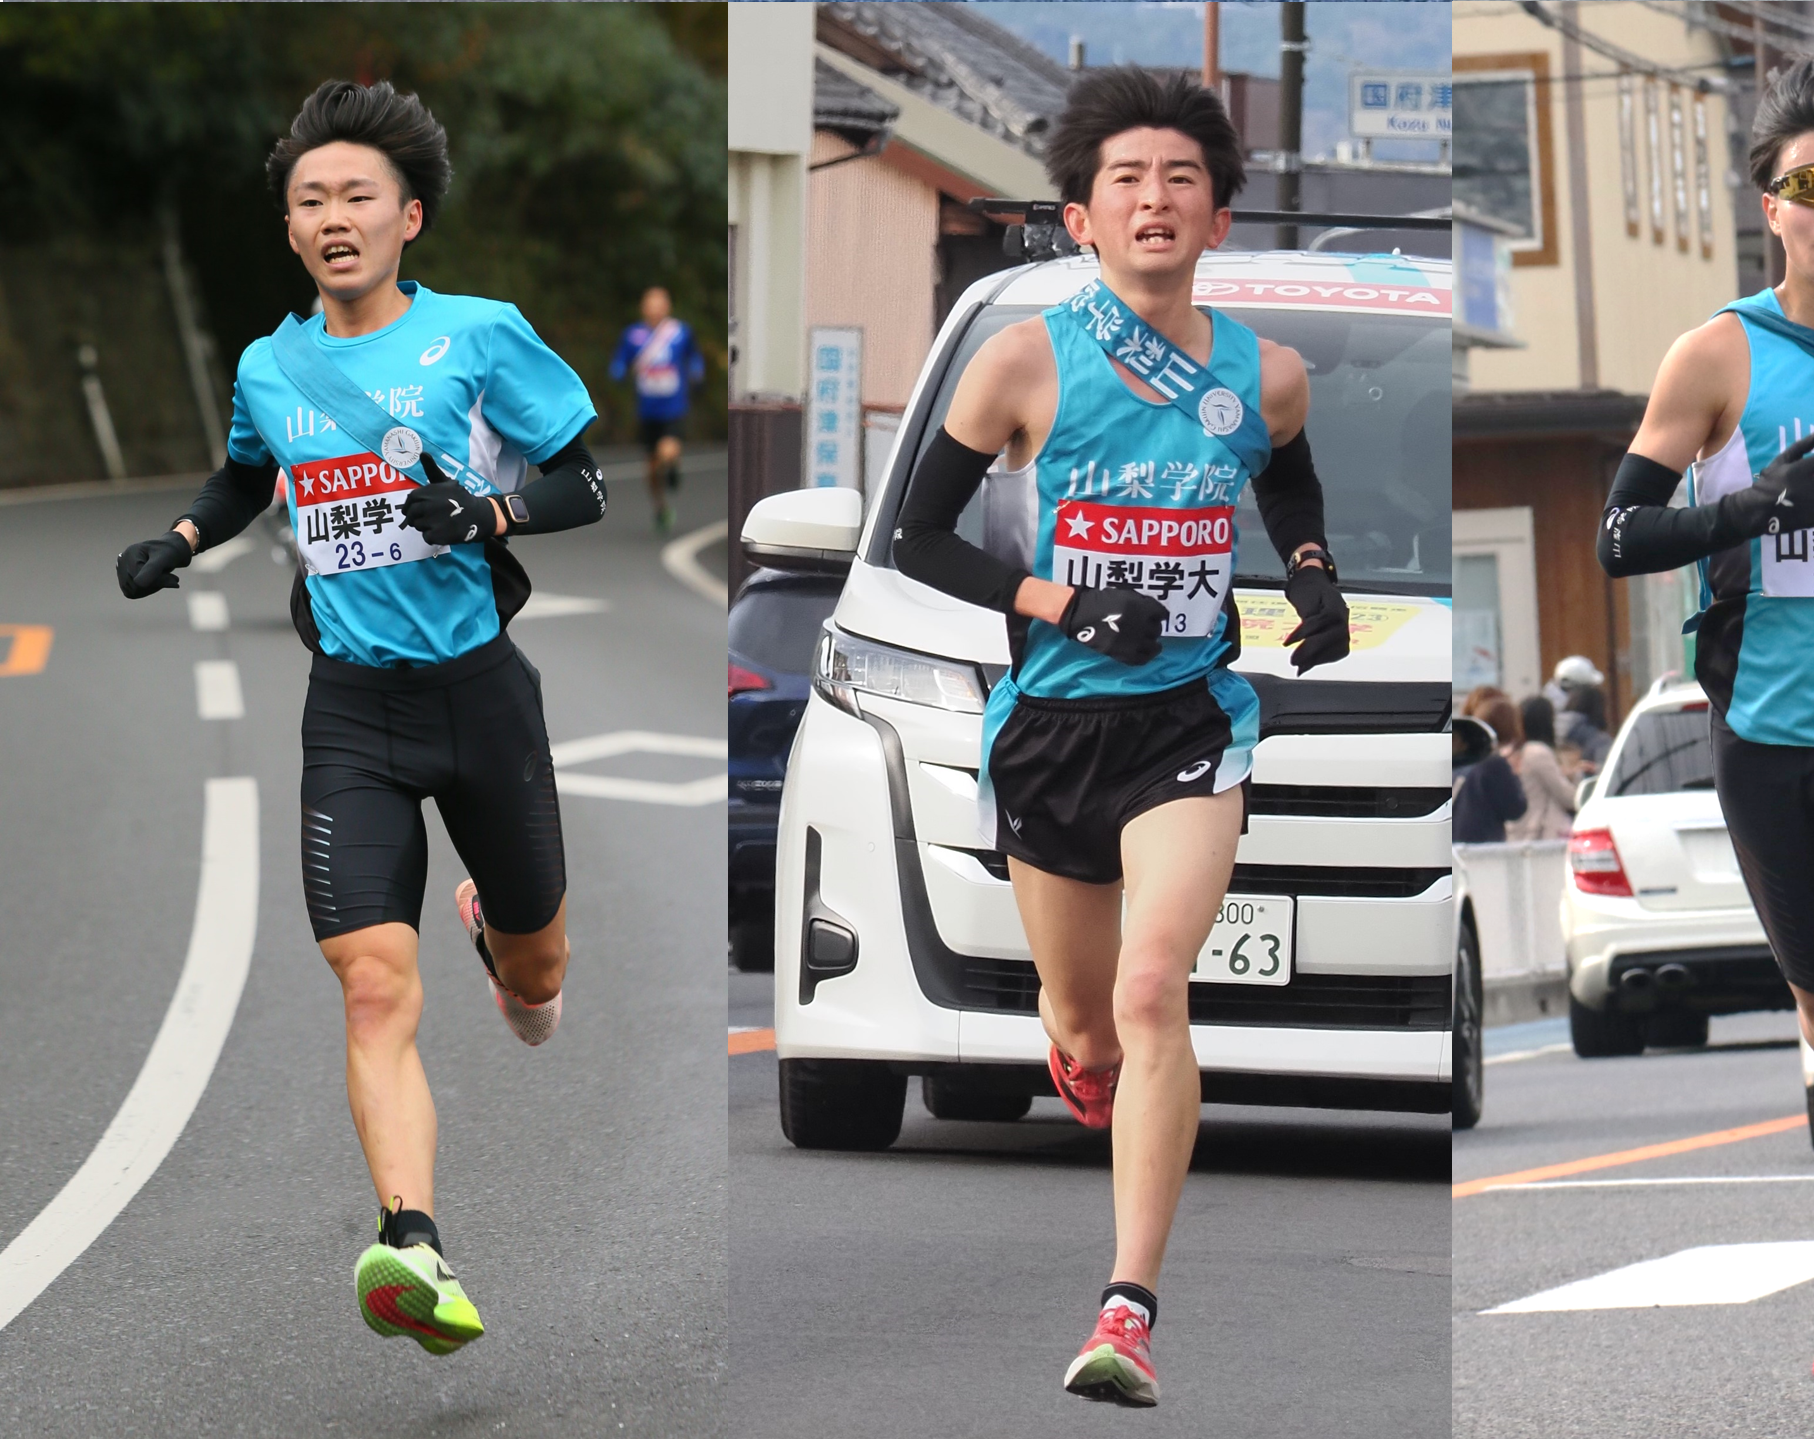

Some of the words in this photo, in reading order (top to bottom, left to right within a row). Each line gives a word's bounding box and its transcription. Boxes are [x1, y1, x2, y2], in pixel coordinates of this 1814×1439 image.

[1245, 284, 1440, 305] TOYOTA
[286, 384, 425, 443] 山院
[318, 463, 408, 494] SAPPO
[1068, 460, 1238, 502] 山梨学院
[1101, 517, 1229, 547] SAPPORO
[1067, 555, 1220, 600] 山梨学大
[1192, 933, 1280, 976] -63
